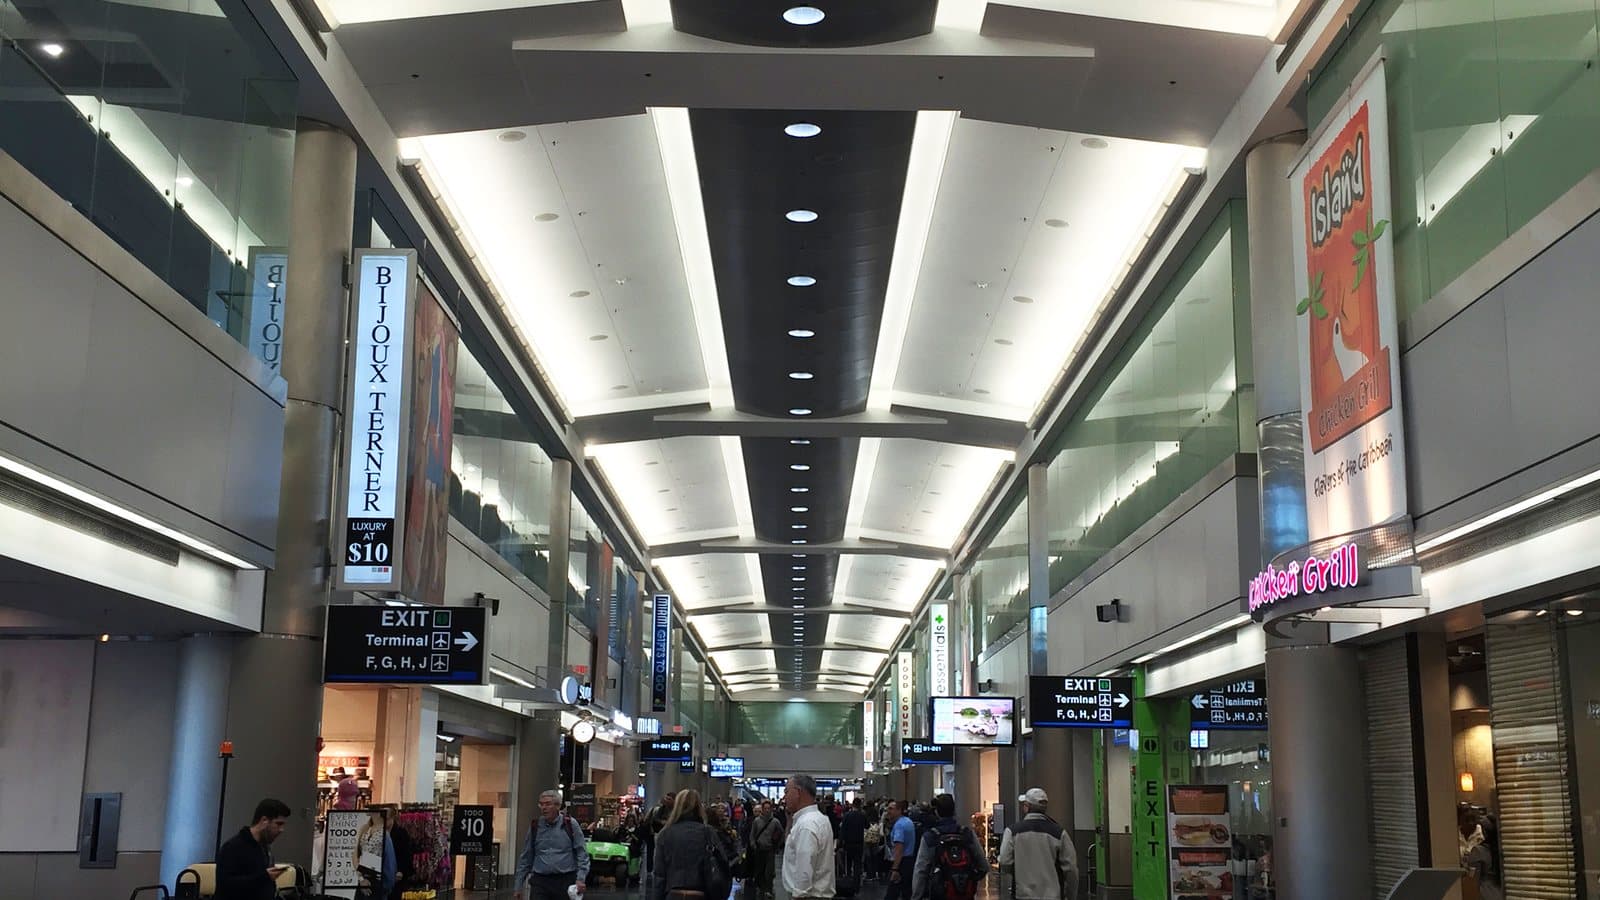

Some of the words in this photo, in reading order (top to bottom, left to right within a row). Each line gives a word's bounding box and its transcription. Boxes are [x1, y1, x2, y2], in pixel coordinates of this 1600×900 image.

[1311, 133, 1365, 247] Island
[369, 266, 392, 383] BIJOUX
[1319, 395, 1355, 437] Chicken
[1358, 367, 1380, 410] Grill
[363, 392, 387, 511] TERNER
[1337, 462, 1345, 485] of
[1346, 459, 1357, 486] the
[1358, 432, 1393, 471] Caribbean
[352, 522, 387, 532] LUXURY
[363, 533, 375, 541] AT
[348, 543, 389, 564] $10
[1303, 542, 1359, 594] Grill
[381, 610, 430, 627] EXIT
[656, 597, 668, 627] MIAMI
[365, 634, 428, 647] Terminal
[366, 656, 378, 670] F,
[381, 656, 397, 670] G,
[400, 656, 415, 670] H,
[418, 656, 427, 669] J
[656, 659, 665, 673] TO
[934, 625, 946, 694] essentials
[655, 676, 665, 692] GO
[1064, 679, 1096, 691] EXIT
[1055, 694, 1097, 704] Terminal
[1057, 710, 1065, 720] F,
[1066, 710, 1078, 720] G,
[1080, 710, 1091, 720] H,
[1092, 710, 1098, 719] J
[460, 818, 485, 837] $10
[1146, 780, 1160, 857] EXIT
[329, 829, 358, 837] TODO
